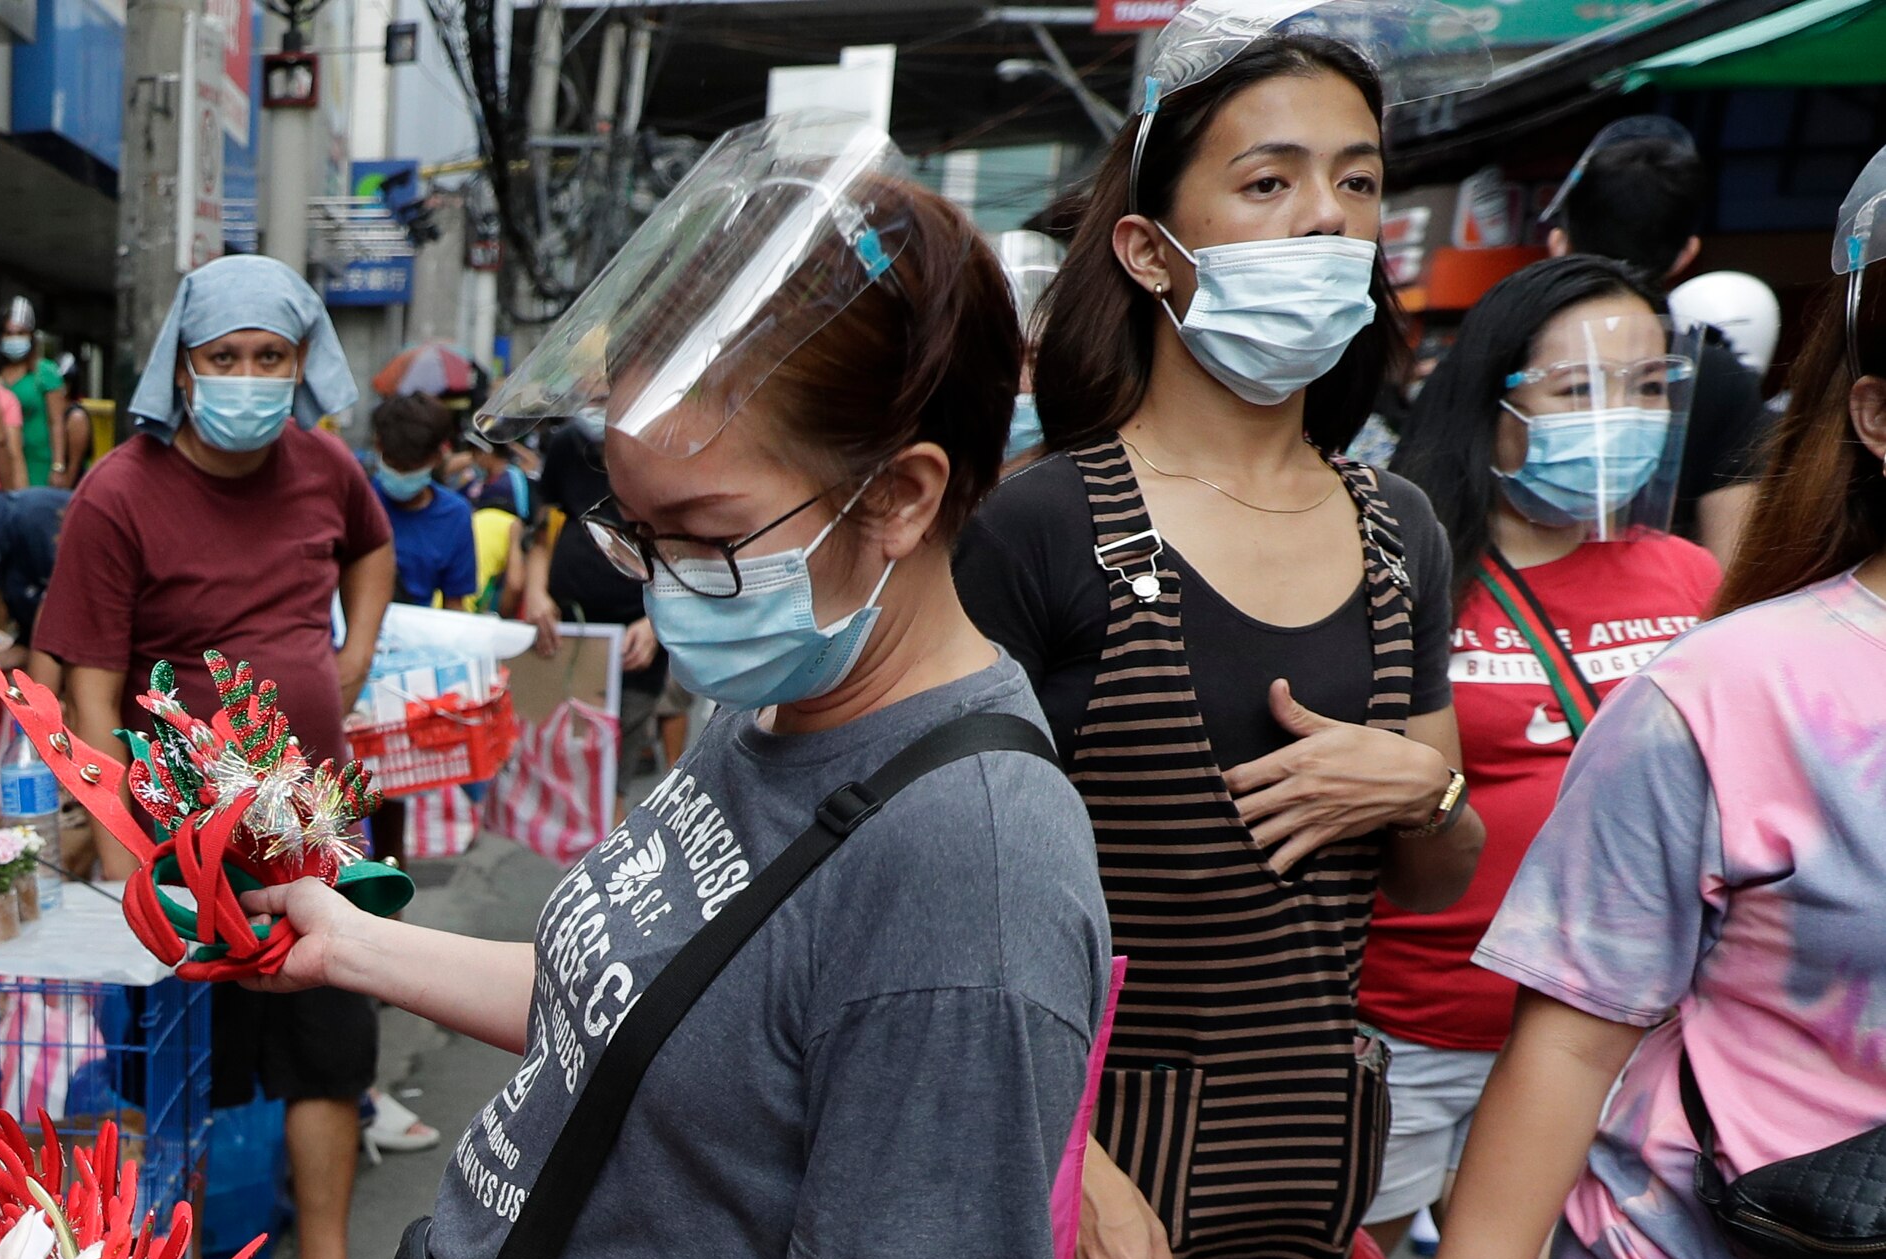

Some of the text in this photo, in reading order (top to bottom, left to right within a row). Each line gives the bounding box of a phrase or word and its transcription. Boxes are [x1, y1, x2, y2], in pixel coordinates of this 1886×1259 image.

[1466, 659, 1543, 677] BETTE
[552, 998, 586, 1095] GOODS
[487, 1121, 521, 1170] BRAND
